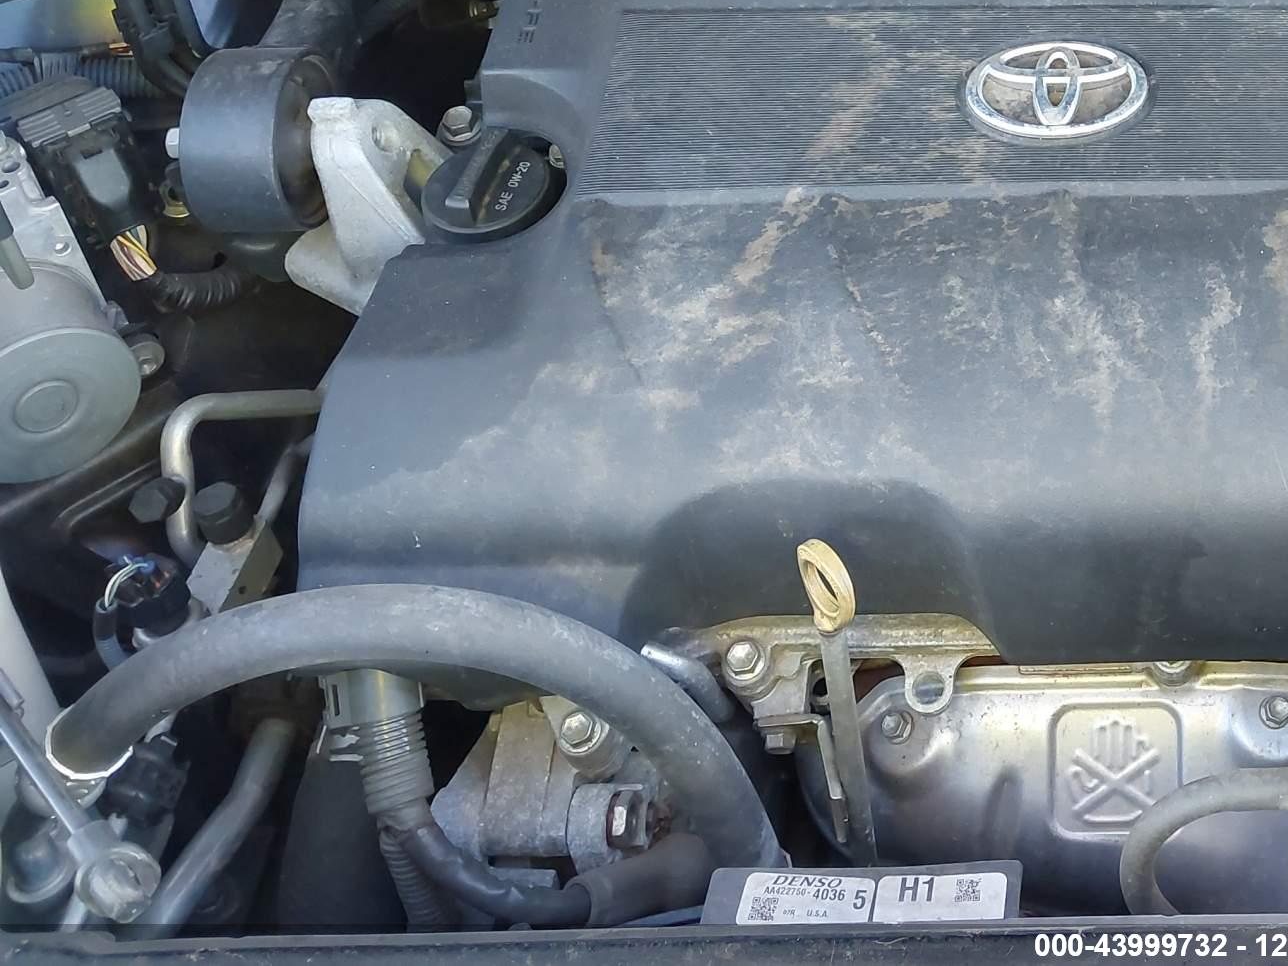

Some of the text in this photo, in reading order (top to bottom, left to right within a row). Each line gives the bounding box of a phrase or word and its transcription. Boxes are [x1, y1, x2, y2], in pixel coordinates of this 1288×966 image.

[495, 161, 531, 211] SAE 0W-20
[773, 874, 843, 888] DENSO
[899, 876, 935, 903] H1
[852, 889, 868, 910] 5
